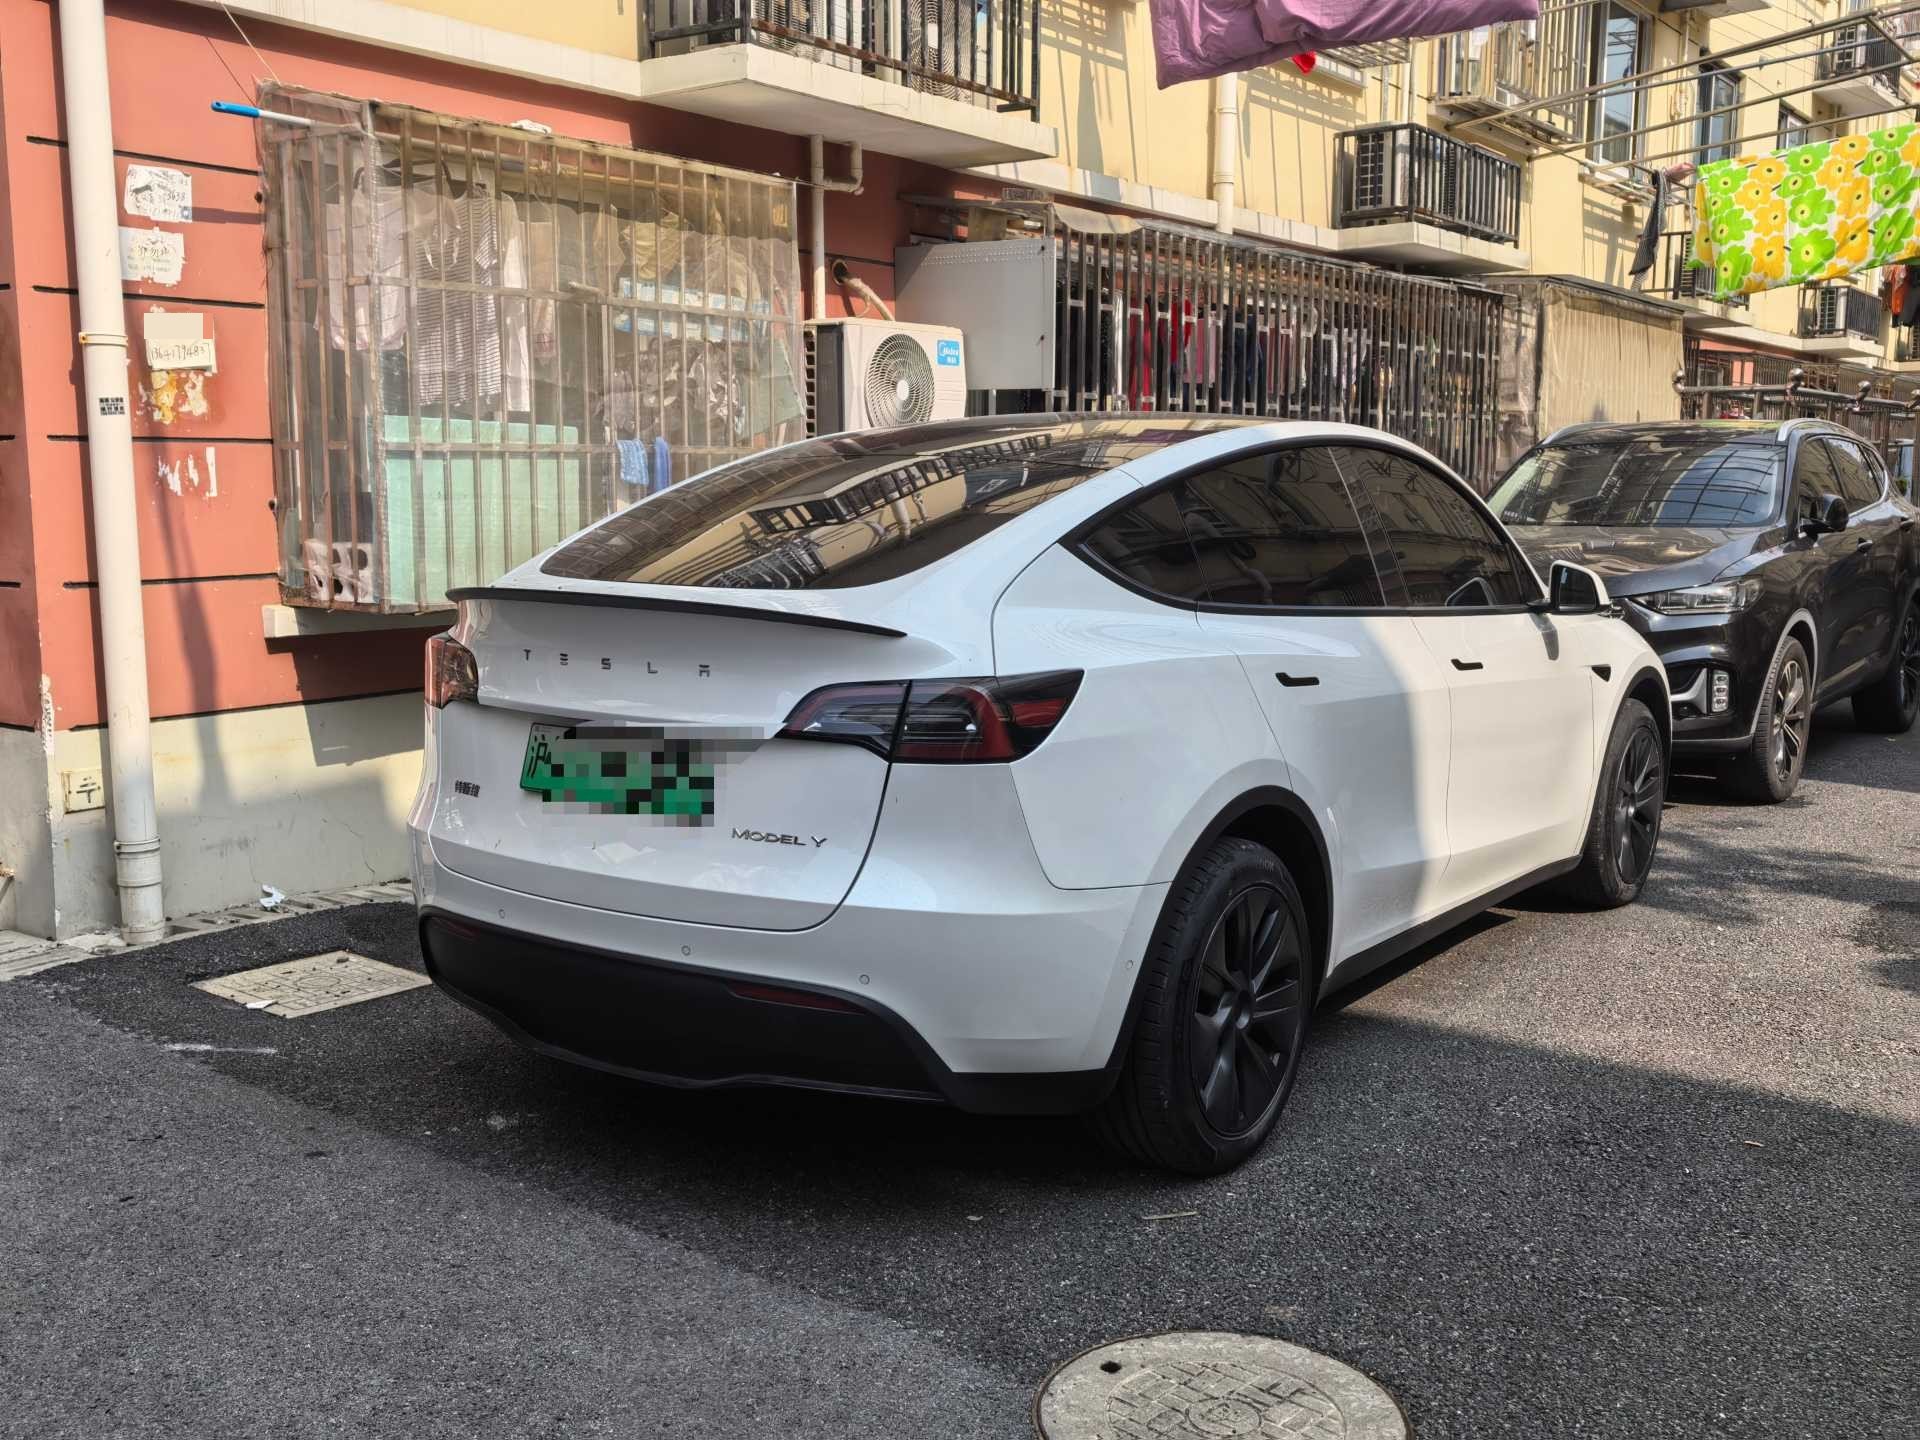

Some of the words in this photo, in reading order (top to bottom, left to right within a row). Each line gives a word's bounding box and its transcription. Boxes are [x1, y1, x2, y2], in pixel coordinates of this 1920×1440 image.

[523, 649, 710, 677] TESLA
[732, 827, 807, 846] MODEL
[811, 835, 827, 848] Y
